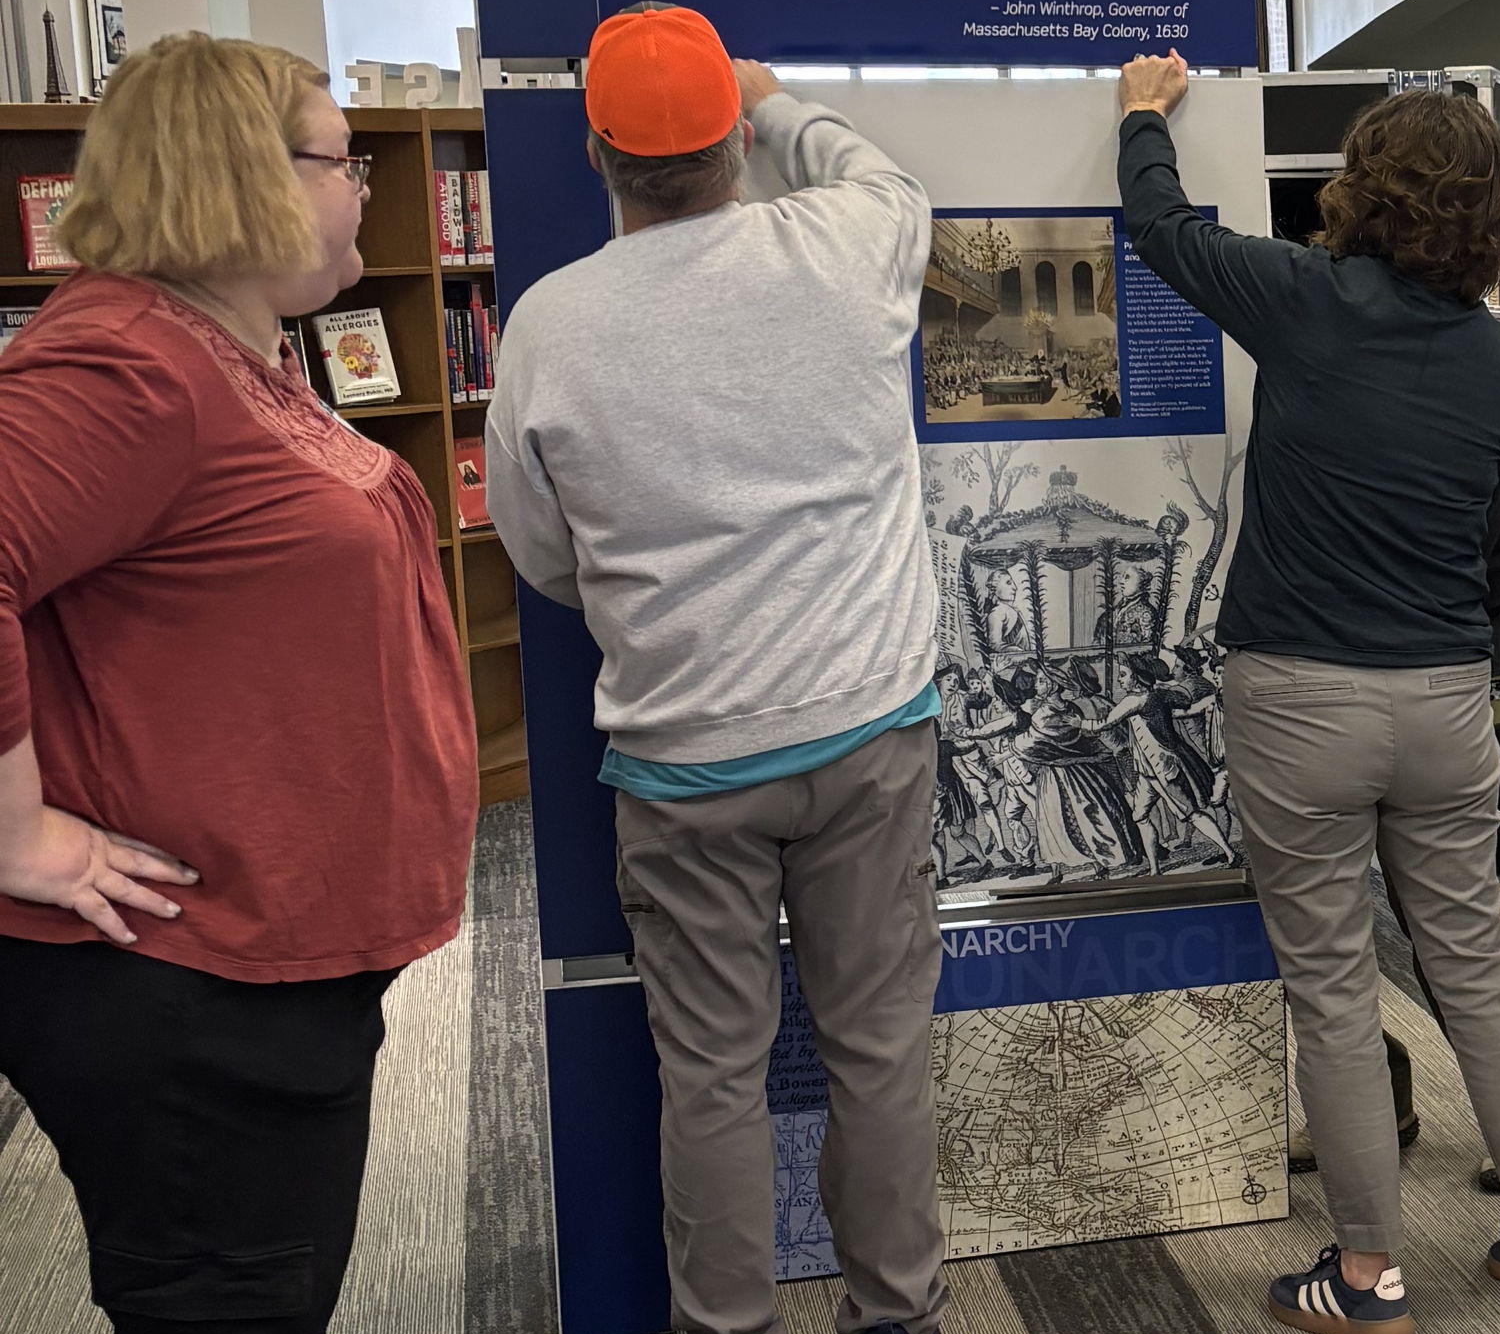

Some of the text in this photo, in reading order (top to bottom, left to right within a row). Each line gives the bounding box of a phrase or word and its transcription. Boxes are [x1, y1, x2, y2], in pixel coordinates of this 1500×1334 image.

[1003, 1, 1189, 19] John Winthrop, Governor of
[964, 23, 1188, 41] Massachusetts Bay Colony, 1630
[20, 182, 74, 199] DEFIAN
[439, 184, 451, 241] ATWOOD
[451, 179, 463, 246] BALDWIN
[325, 319, 379, 332] ALLERGIES
[939, 921, 1076, 959] NARCHY
[1120, 1095, 1225, 1140] ATLANTIC
[951, 1245, 982, 1256] TH
